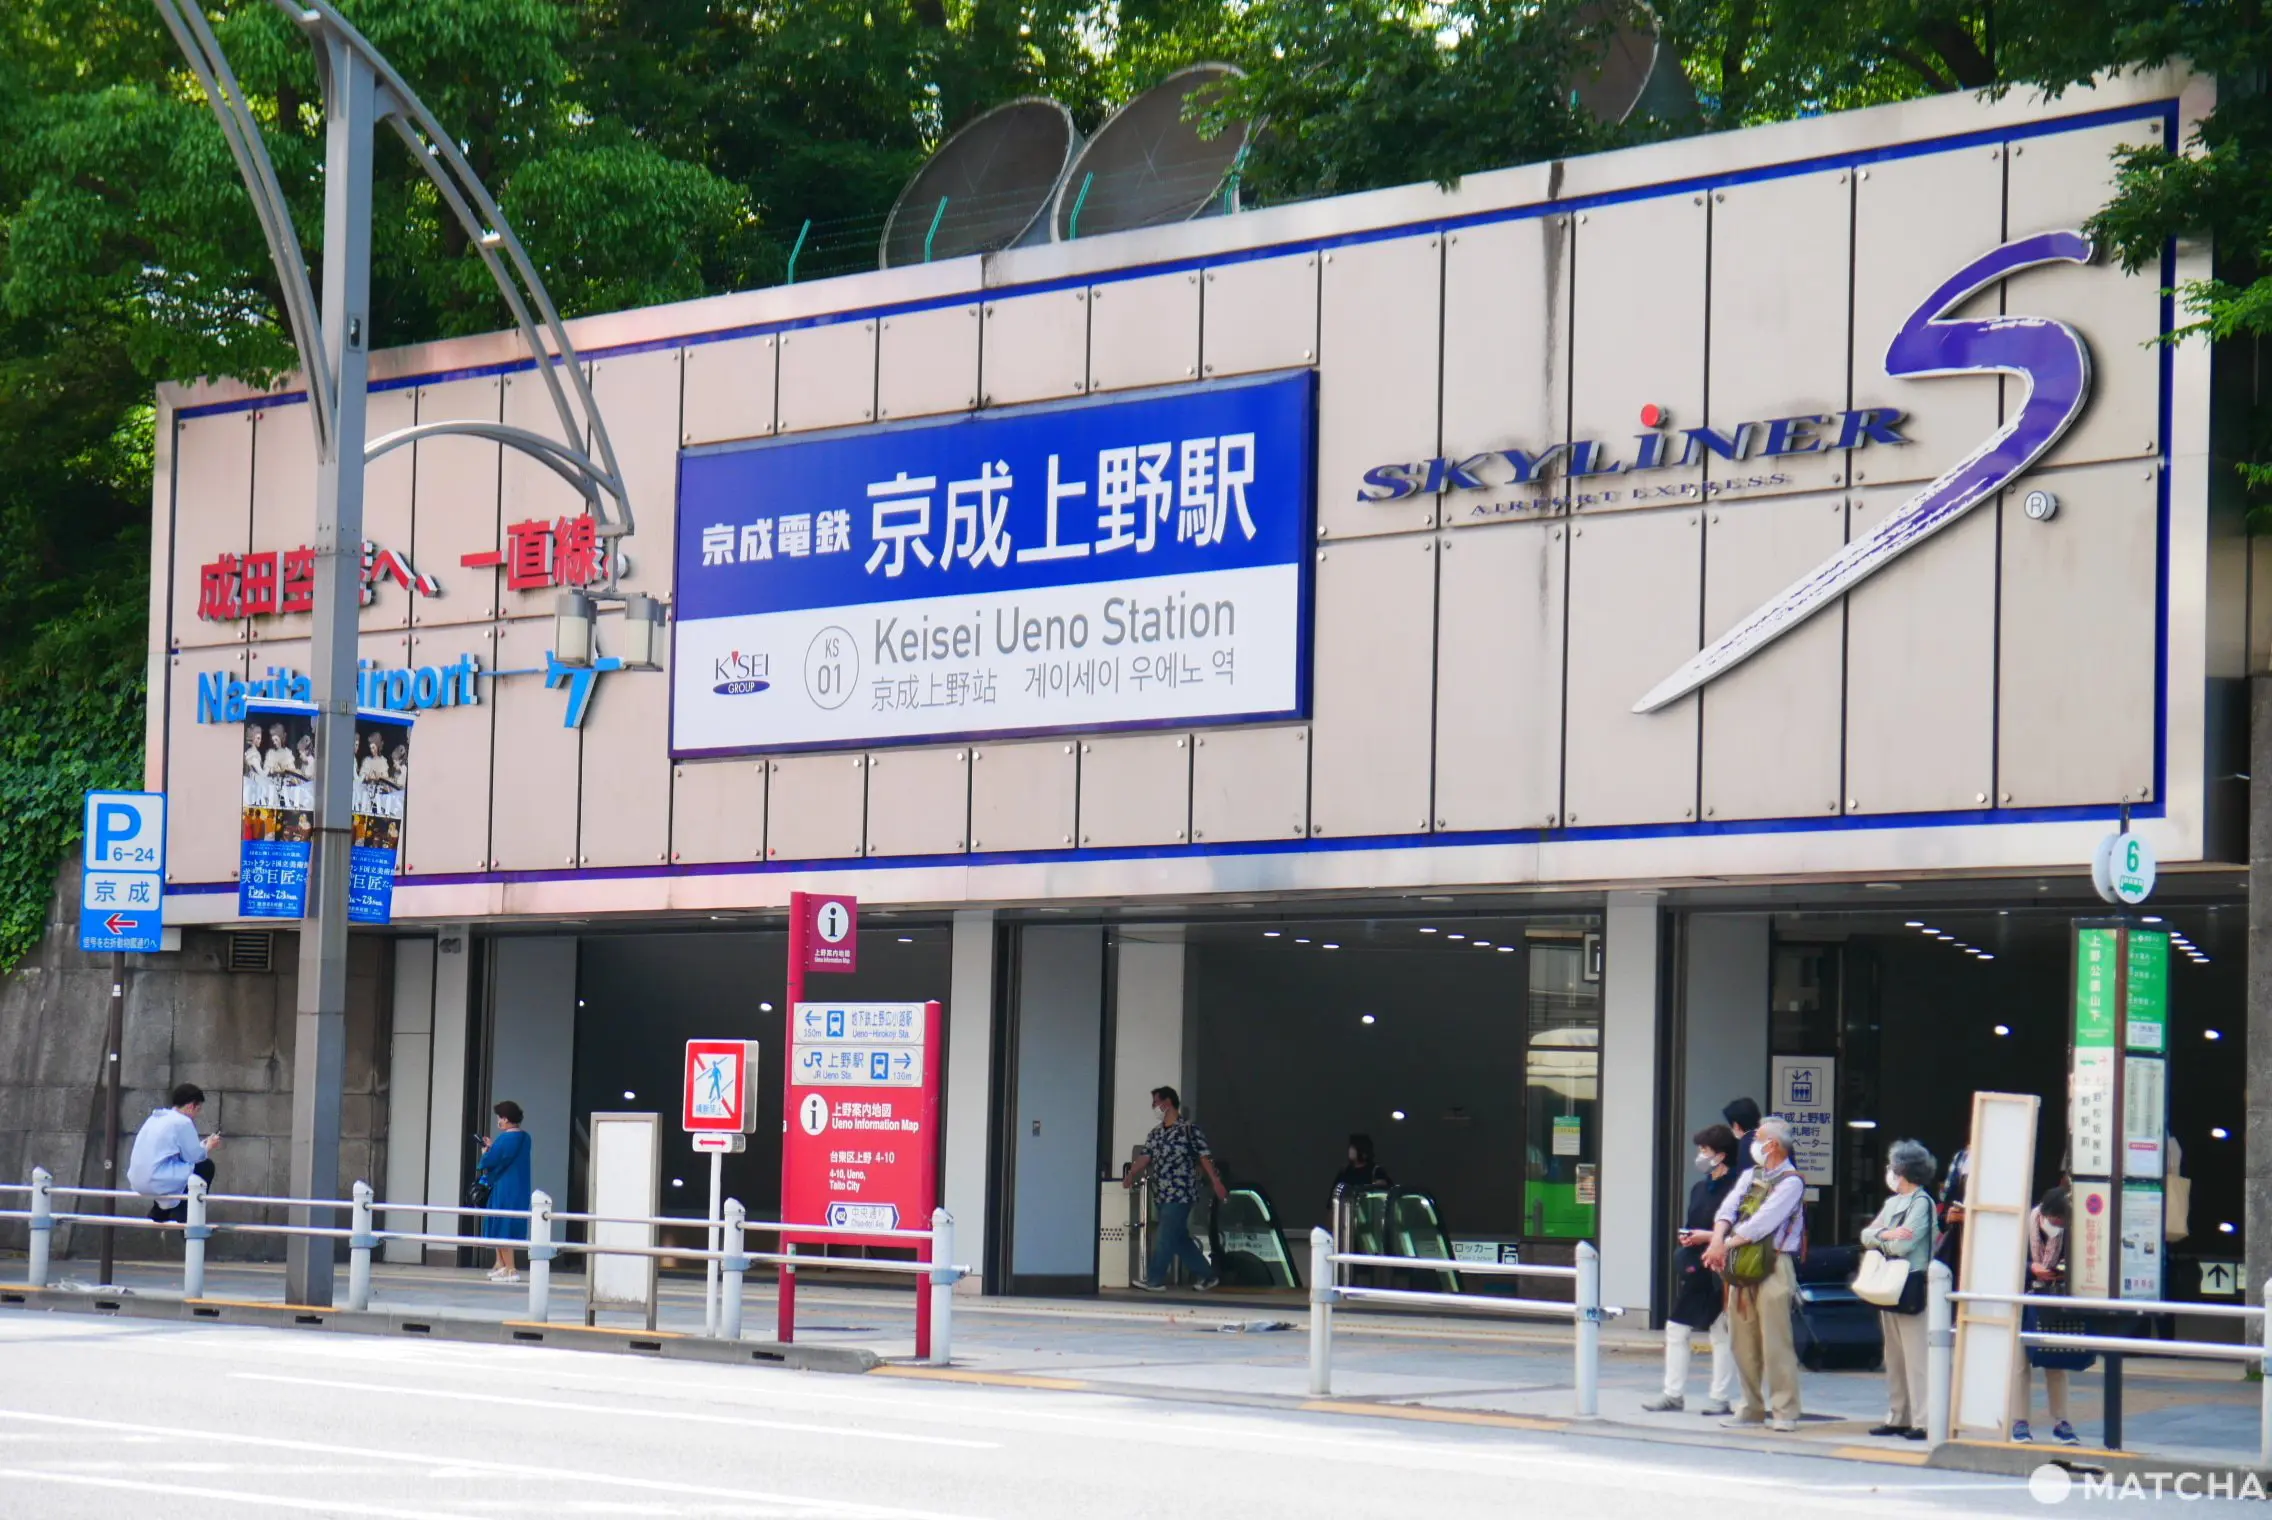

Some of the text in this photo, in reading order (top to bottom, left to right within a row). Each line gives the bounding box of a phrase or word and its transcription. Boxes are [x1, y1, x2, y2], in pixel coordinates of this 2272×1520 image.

[1357, 403, 1914, 504] SKYLINER
[702, 431, 1257, 578] 京成電鉄 京成上野駅
[197, 539, 439, 622] 成田空へ、
[874, 590, 1235, 665] Keisei Ueno Station
[824, 638, 840, 659] KS
[356, 652, 478, 711] irport
[817, 663, 842, 695] 01
[1023, 647, 1235, 700] 게이세이 우에노 역
[727, 681, 756, 694] GROUP
[871, 667, 999, 712] 京成上野站
[112, 847, 155, 862] 6-24
[2127, 840, 2140, 873] 6
[94, 880, 151, 903] 京成
[803, 1051, 865, 1069] JR 上野駅
[822, 1071, 840, 1080] Ueno
[831, 1102, 892, 1118] 上野案内地図
[831, 1118, 919, 1133] Ueno Information Map
[829, 1150, 895, 1164] 台東区上野 4-10
[829, 1168, 866, 1181] 4-10, Ueno,
[829, 1180, 860, 1193] Taito City
